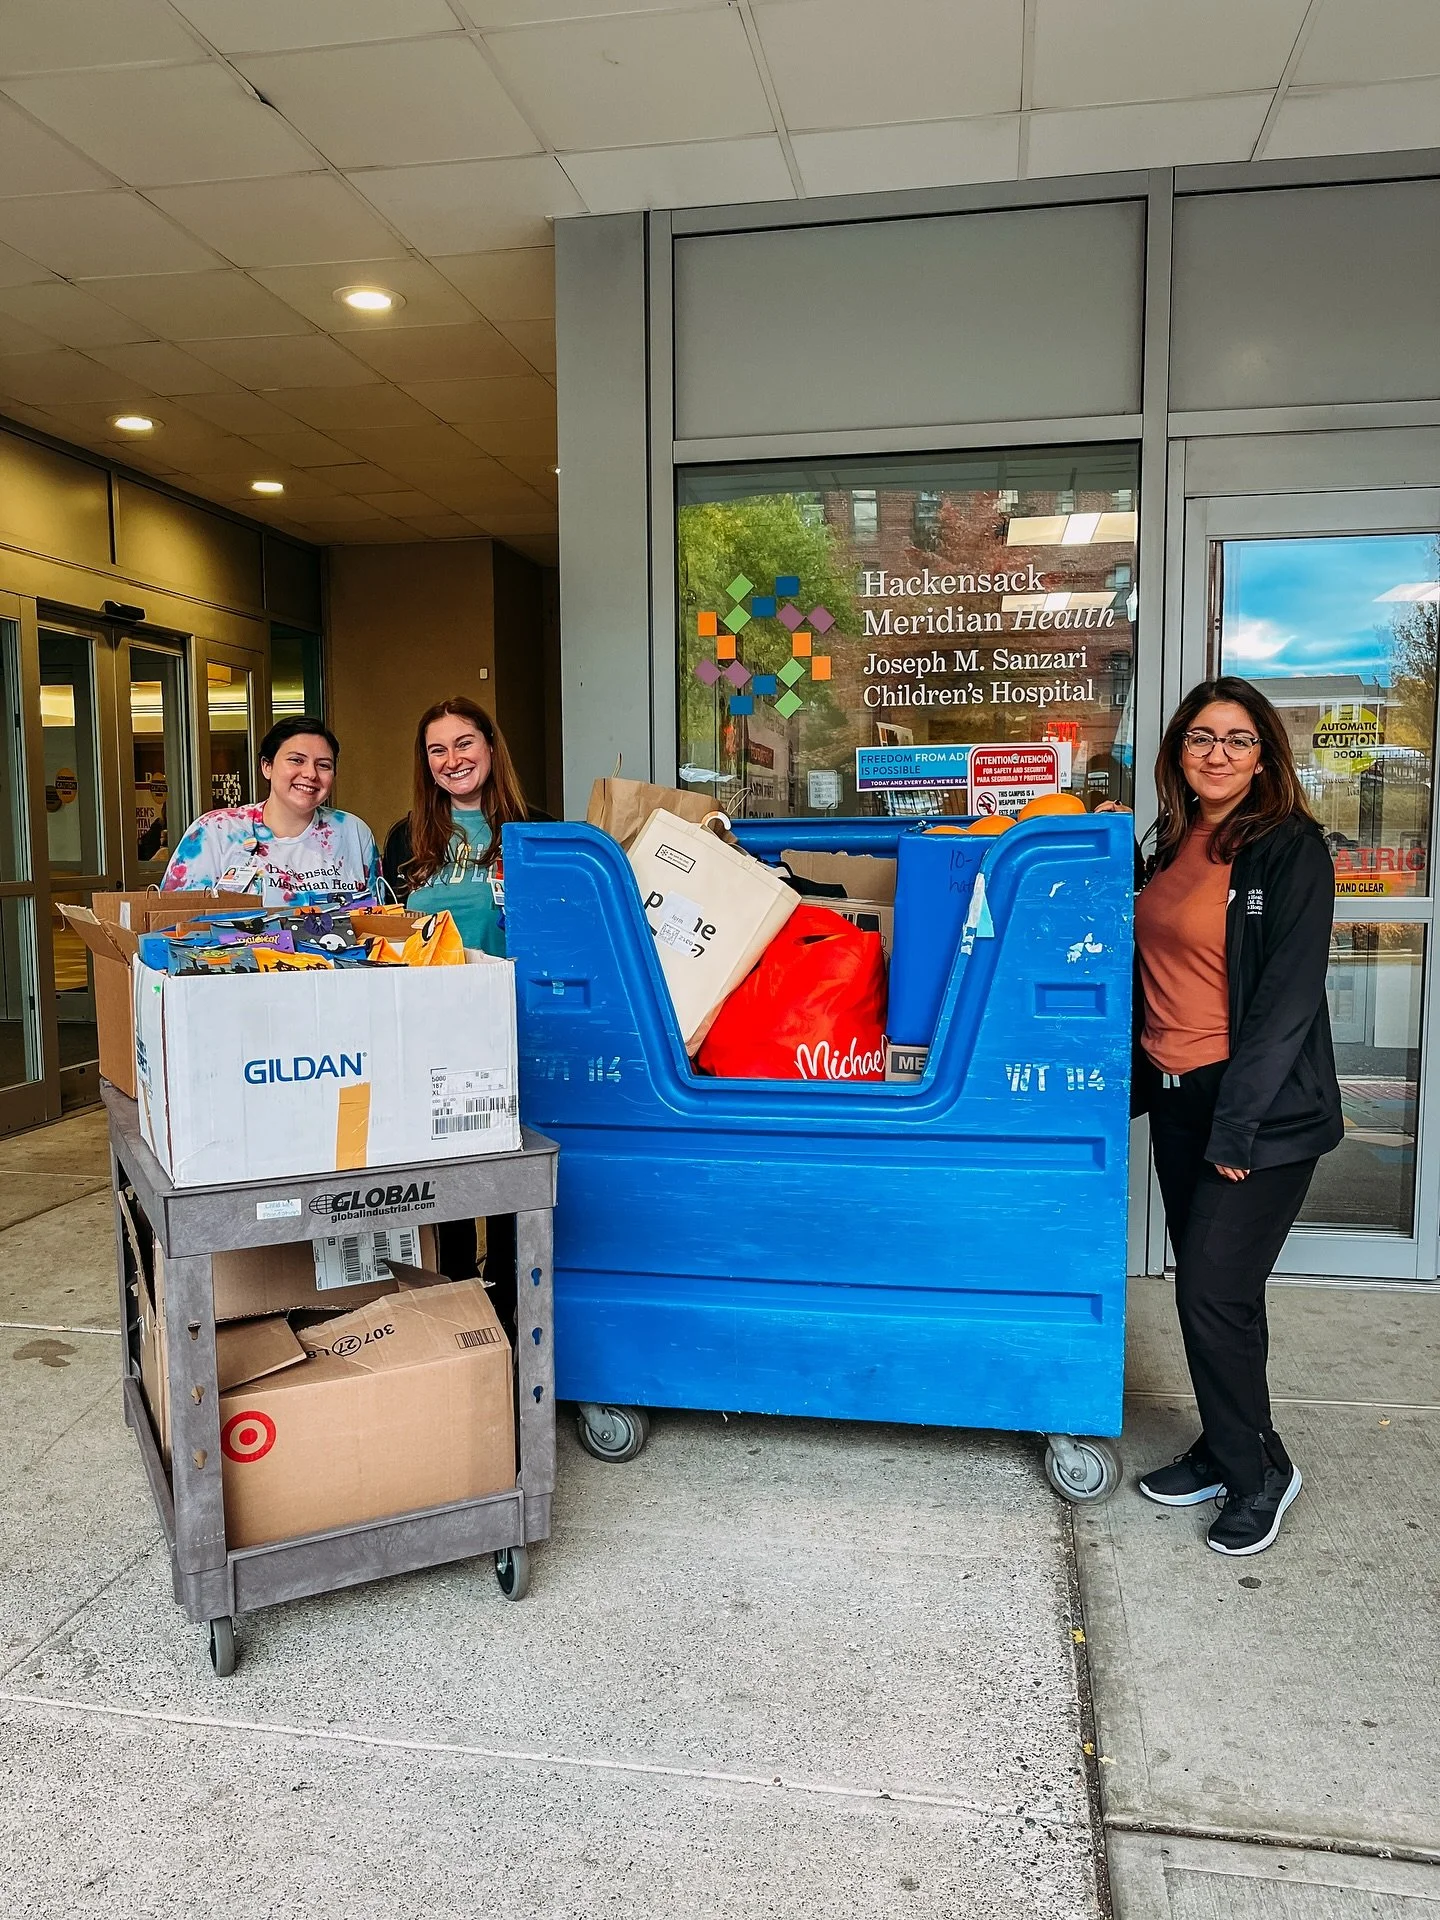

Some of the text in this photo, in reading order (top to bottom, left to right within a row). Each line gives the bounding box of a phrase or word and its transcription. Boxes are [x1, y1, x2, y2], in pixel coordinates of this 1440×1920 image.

[862, 564, 1045, 598] Hackensack
[863, 603, 1115, 636] Meridian Health
[863, 646, 1088, 679] Joseph M. Sanzari
[863, 679, 1094, 708] Children’s Hospital
[1320, 722, 1377, 731] AUTOMATIC
[1317, 734, 1379, 747] CAUTION
[861, 754, 912, 764] FREEDOM
[915, 753, 946, 762] FROM
[1333, 750, 1363, 759] DOOR
[861, 765, 921, 775] IS POSSIBLE
[1012, 766, 1023, 774] AND
[268, 878, 331, 892] Meridian
[1358, 883, 1384, 893] CLEAR
[588, 1056, 621, 1083] 114
[1005, 1063, 1106, 1092] WT 114
[332, 1181, 436, 1213] GLOBAL
[330, 1201, 436, 1224] globalindustrial.com
[364, 1323, 395, 1345] 307
[338, 1337, 357, 1354] 27
